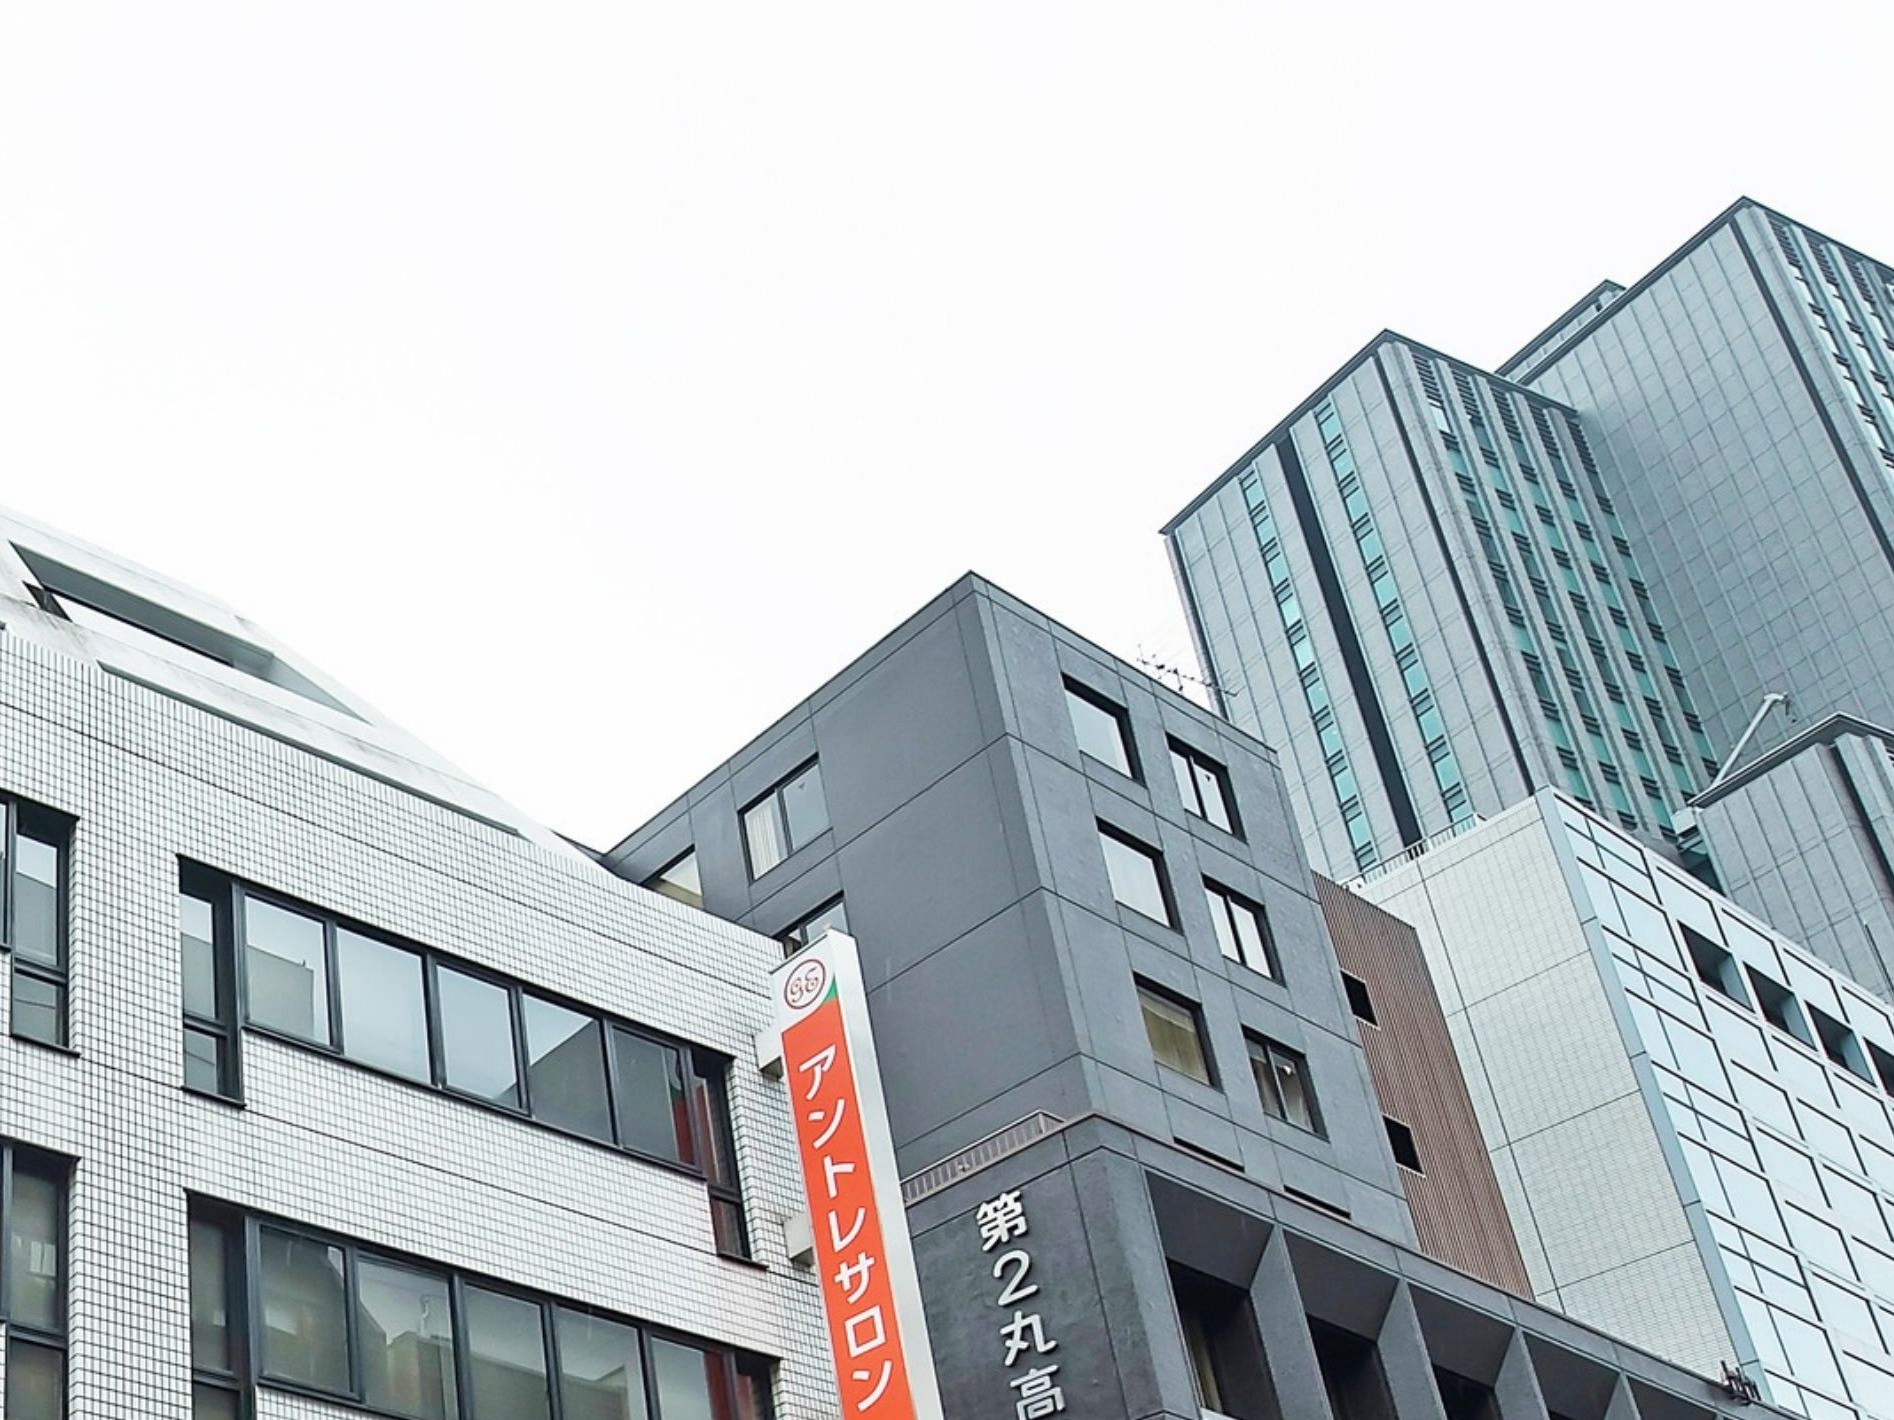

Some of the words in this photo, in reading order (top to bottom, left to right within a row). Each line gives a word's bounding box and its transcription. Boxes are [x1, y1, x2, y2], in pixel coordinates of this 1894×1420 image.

[798, 1043, 895, 1411] アントレサロン
